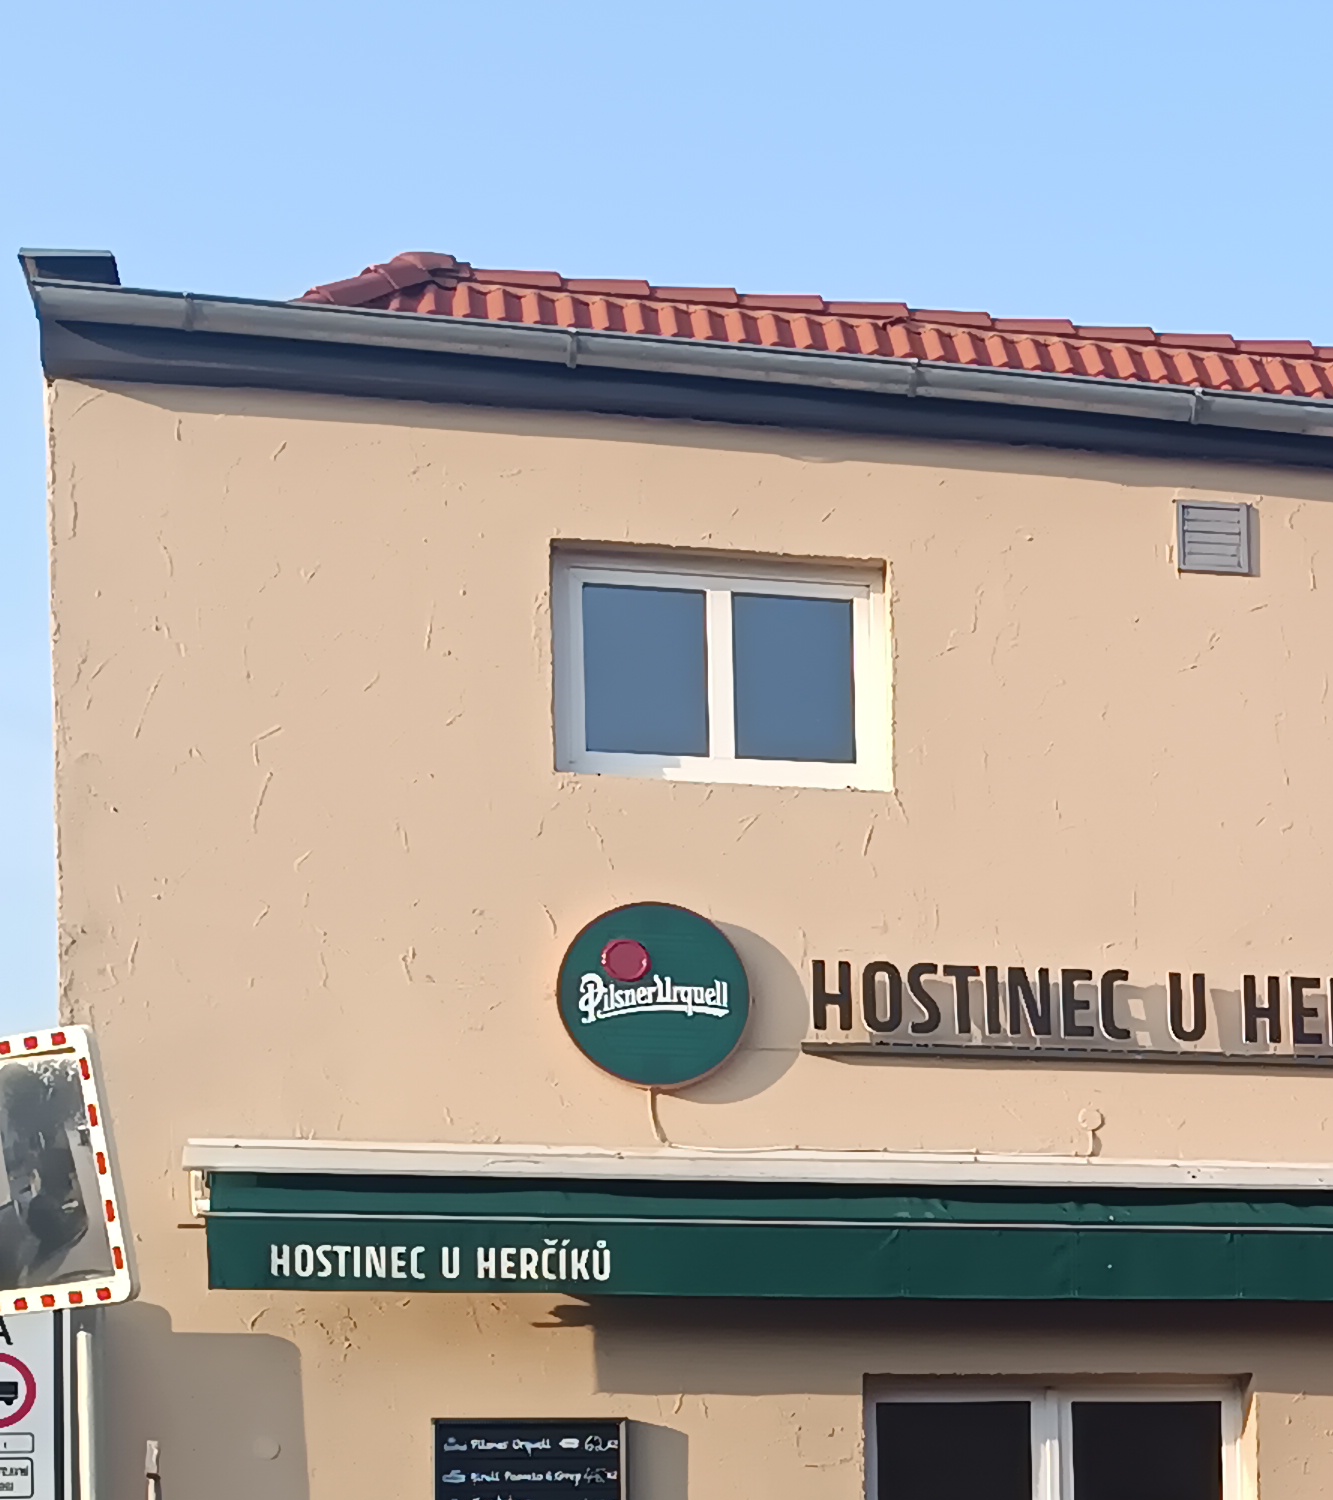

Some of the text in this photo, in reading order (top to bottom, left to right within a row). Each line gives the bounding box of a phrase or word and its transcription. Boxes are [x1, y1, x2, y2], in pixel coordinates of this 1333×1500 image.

[579, 973, 728, 1023] Pilsner Urquell
[811, 960, 1131, 1040] HOSTINEC
[1167, 972, 1206, 1042] U
[270, 1238, 612, 1281] HOSTINEC U HERČÍKŮ
